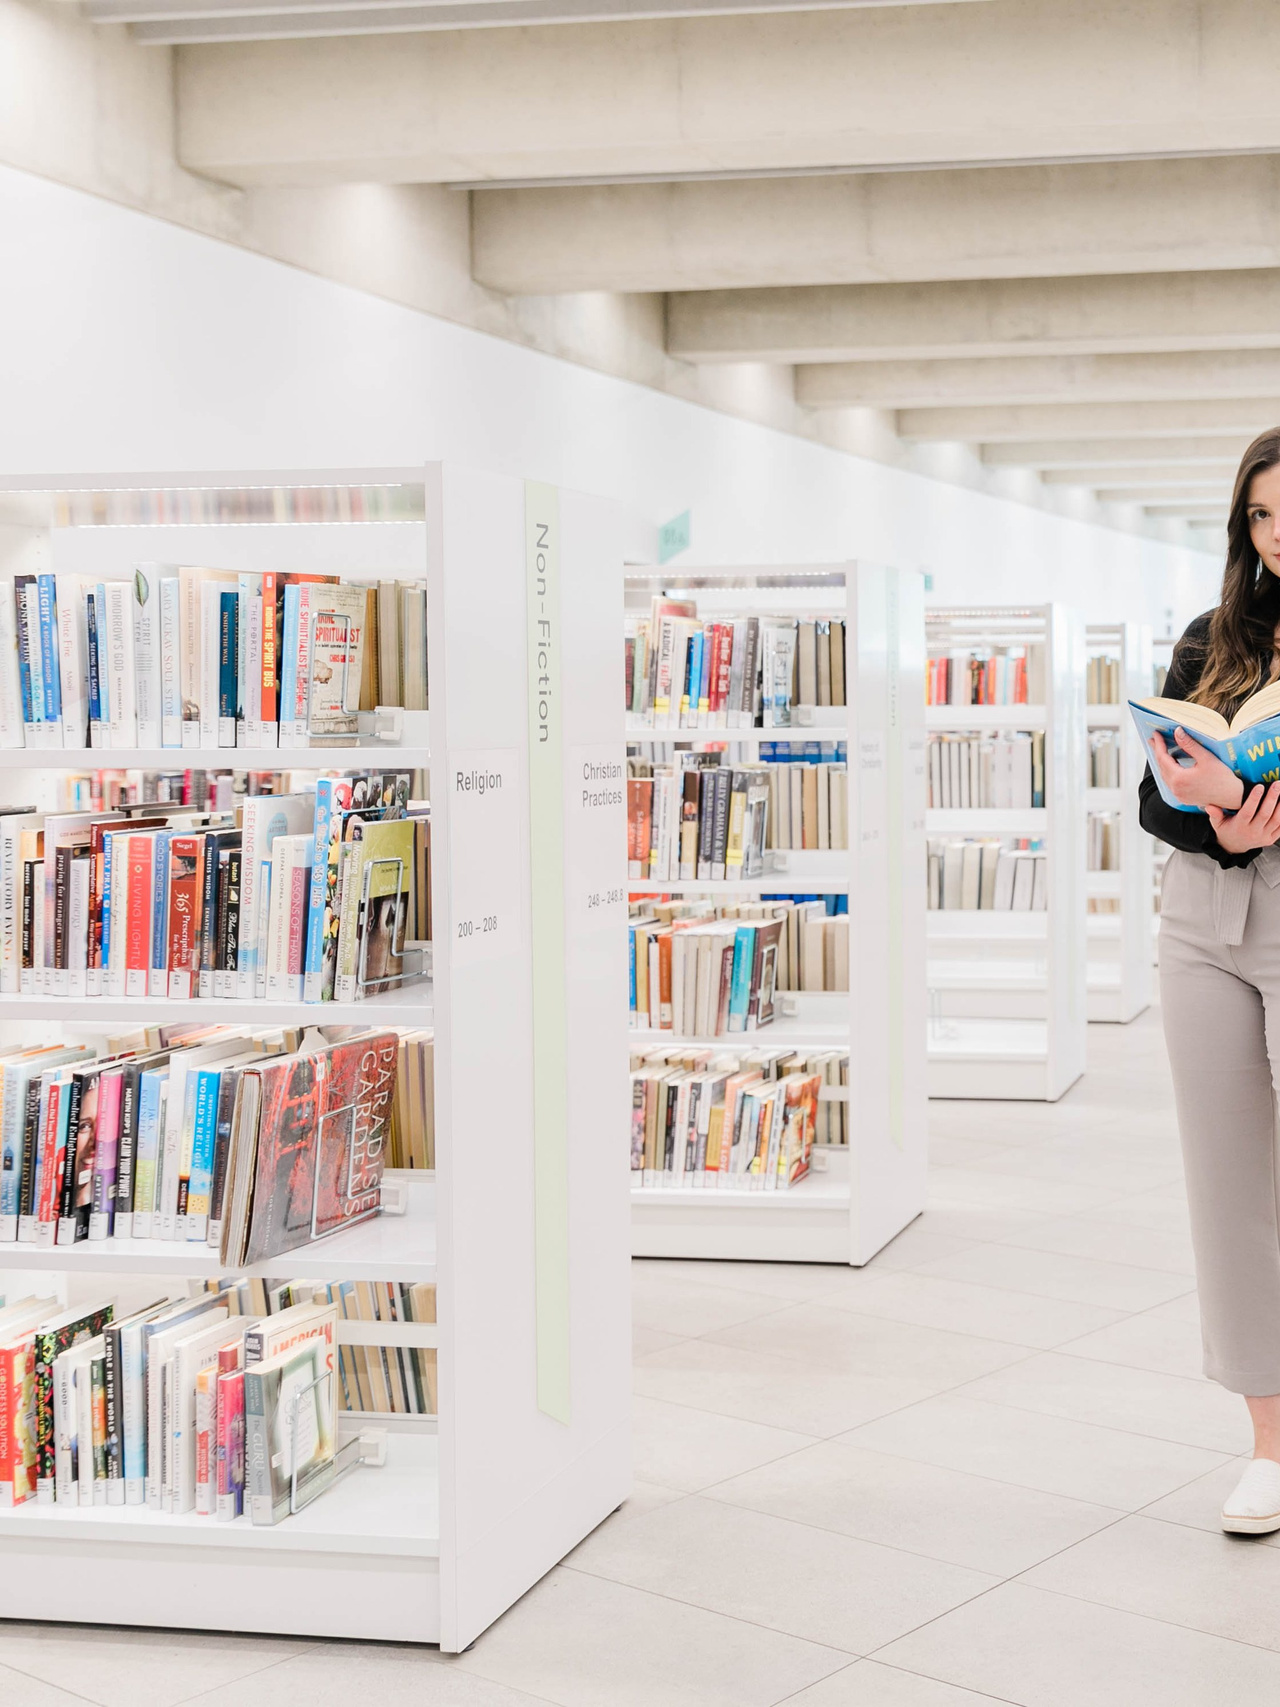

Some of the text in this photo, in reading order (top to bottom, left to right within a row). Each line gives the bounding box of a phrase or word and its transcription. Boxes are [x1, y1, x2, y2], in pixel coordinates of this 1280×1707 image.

[163, 583, 174, 651] GARY ZUKAV
[299, 587, 309, 608] INDIE
[62, 608, 72, 657] White Fire
[111, 588, 124, 671] TOMORROW'S GOD
[142, 617, 151, 646] SPIRIT
[264, 606, 274, 687] RIDING THE SPIRIT BUS
[298, 611, 309, 669] SPIRITUALIST
[535, 522, 552, 744] Non-Fiction
[660, 628, 671, 662] RADICAL
[660, 664, 671, 688] FAITH
[456, 770, 502, 795] Religion
[581, 788, 623, 809] Practices
[582, 761, 622, 781] Christian
[104, 836, 112, 895] SIMPLY PRAY
[155, 840, 164, 902] GOD STORIES
[243, 803, 256, 905] SEEKING WISDOM
[54, 854, 65, 934] praying for strangers
[132, 875, 143, 970] LIVING LIGHTLY
[174, 892, 190, 913] 365
[288, 870, 301, 974] SEASONS OF THANKS
[457, 920, 473, 939] 200
[482, 914, 498, 934] 208
[65, 1081, 82, 1187] Embodied Enlightenment
[343, 1050, 378, 1217] GARDENS
[359, 1046, 394, 1206] PARADISE
[118, 1137, 133, 1198] CLAIM YOUR POWER
[0, 1414, 8, 1459] SOLUTION
